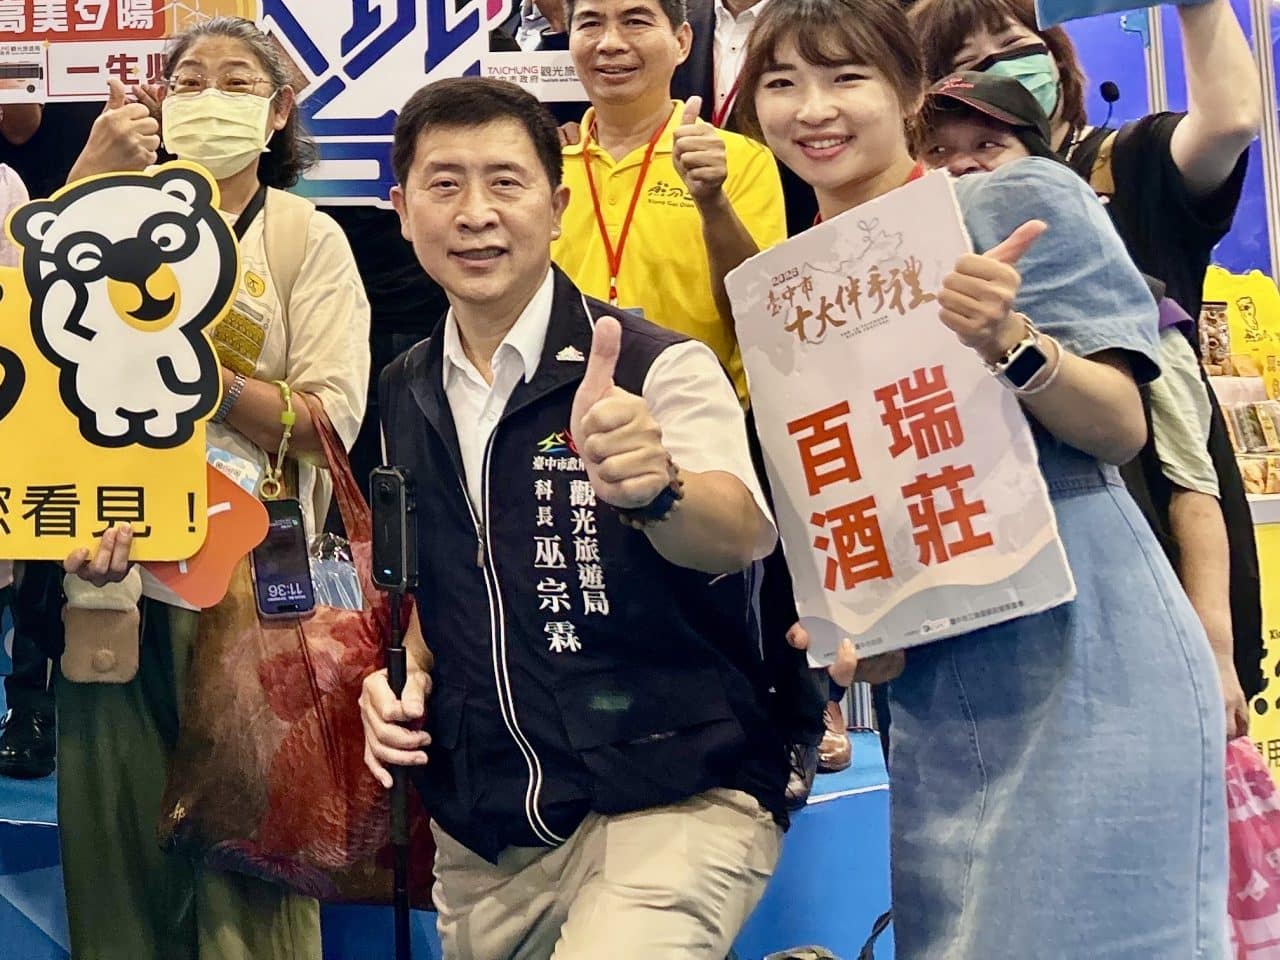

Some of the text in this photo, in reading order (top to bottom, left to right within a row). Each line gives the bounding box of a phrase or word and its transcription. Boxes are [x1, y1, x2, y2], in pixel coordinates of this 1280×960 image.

[268, 583, 303, 597] 11:36
[534, 479, 582, 653] 科長 巫宗霖
[569, 480, 609, 616] 觀光旅遊局
